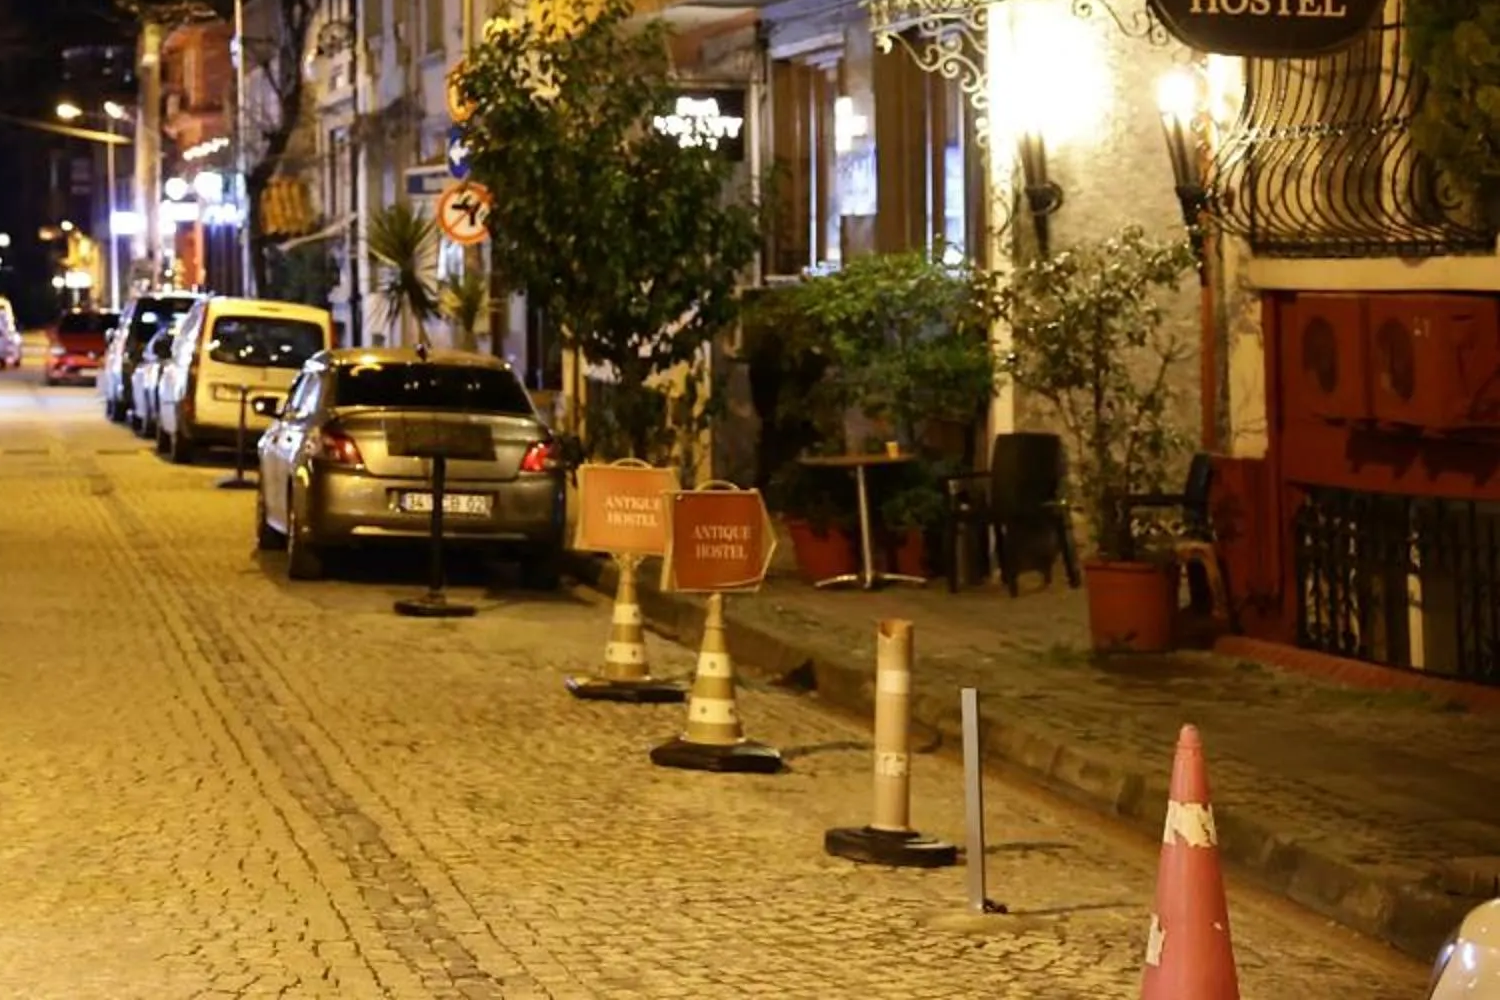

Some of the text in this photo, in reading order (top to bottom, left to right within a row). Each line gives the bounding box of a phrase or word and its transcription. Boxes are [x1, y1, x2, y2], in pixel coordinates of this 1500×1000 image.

[604, 495, 662, 512] ANTIQUE
[607, 511, 659, 528] HOSTEL
[692, 525, 752, 541] ANTIQUE
[695, 544, 748, 560] HOSTEL
